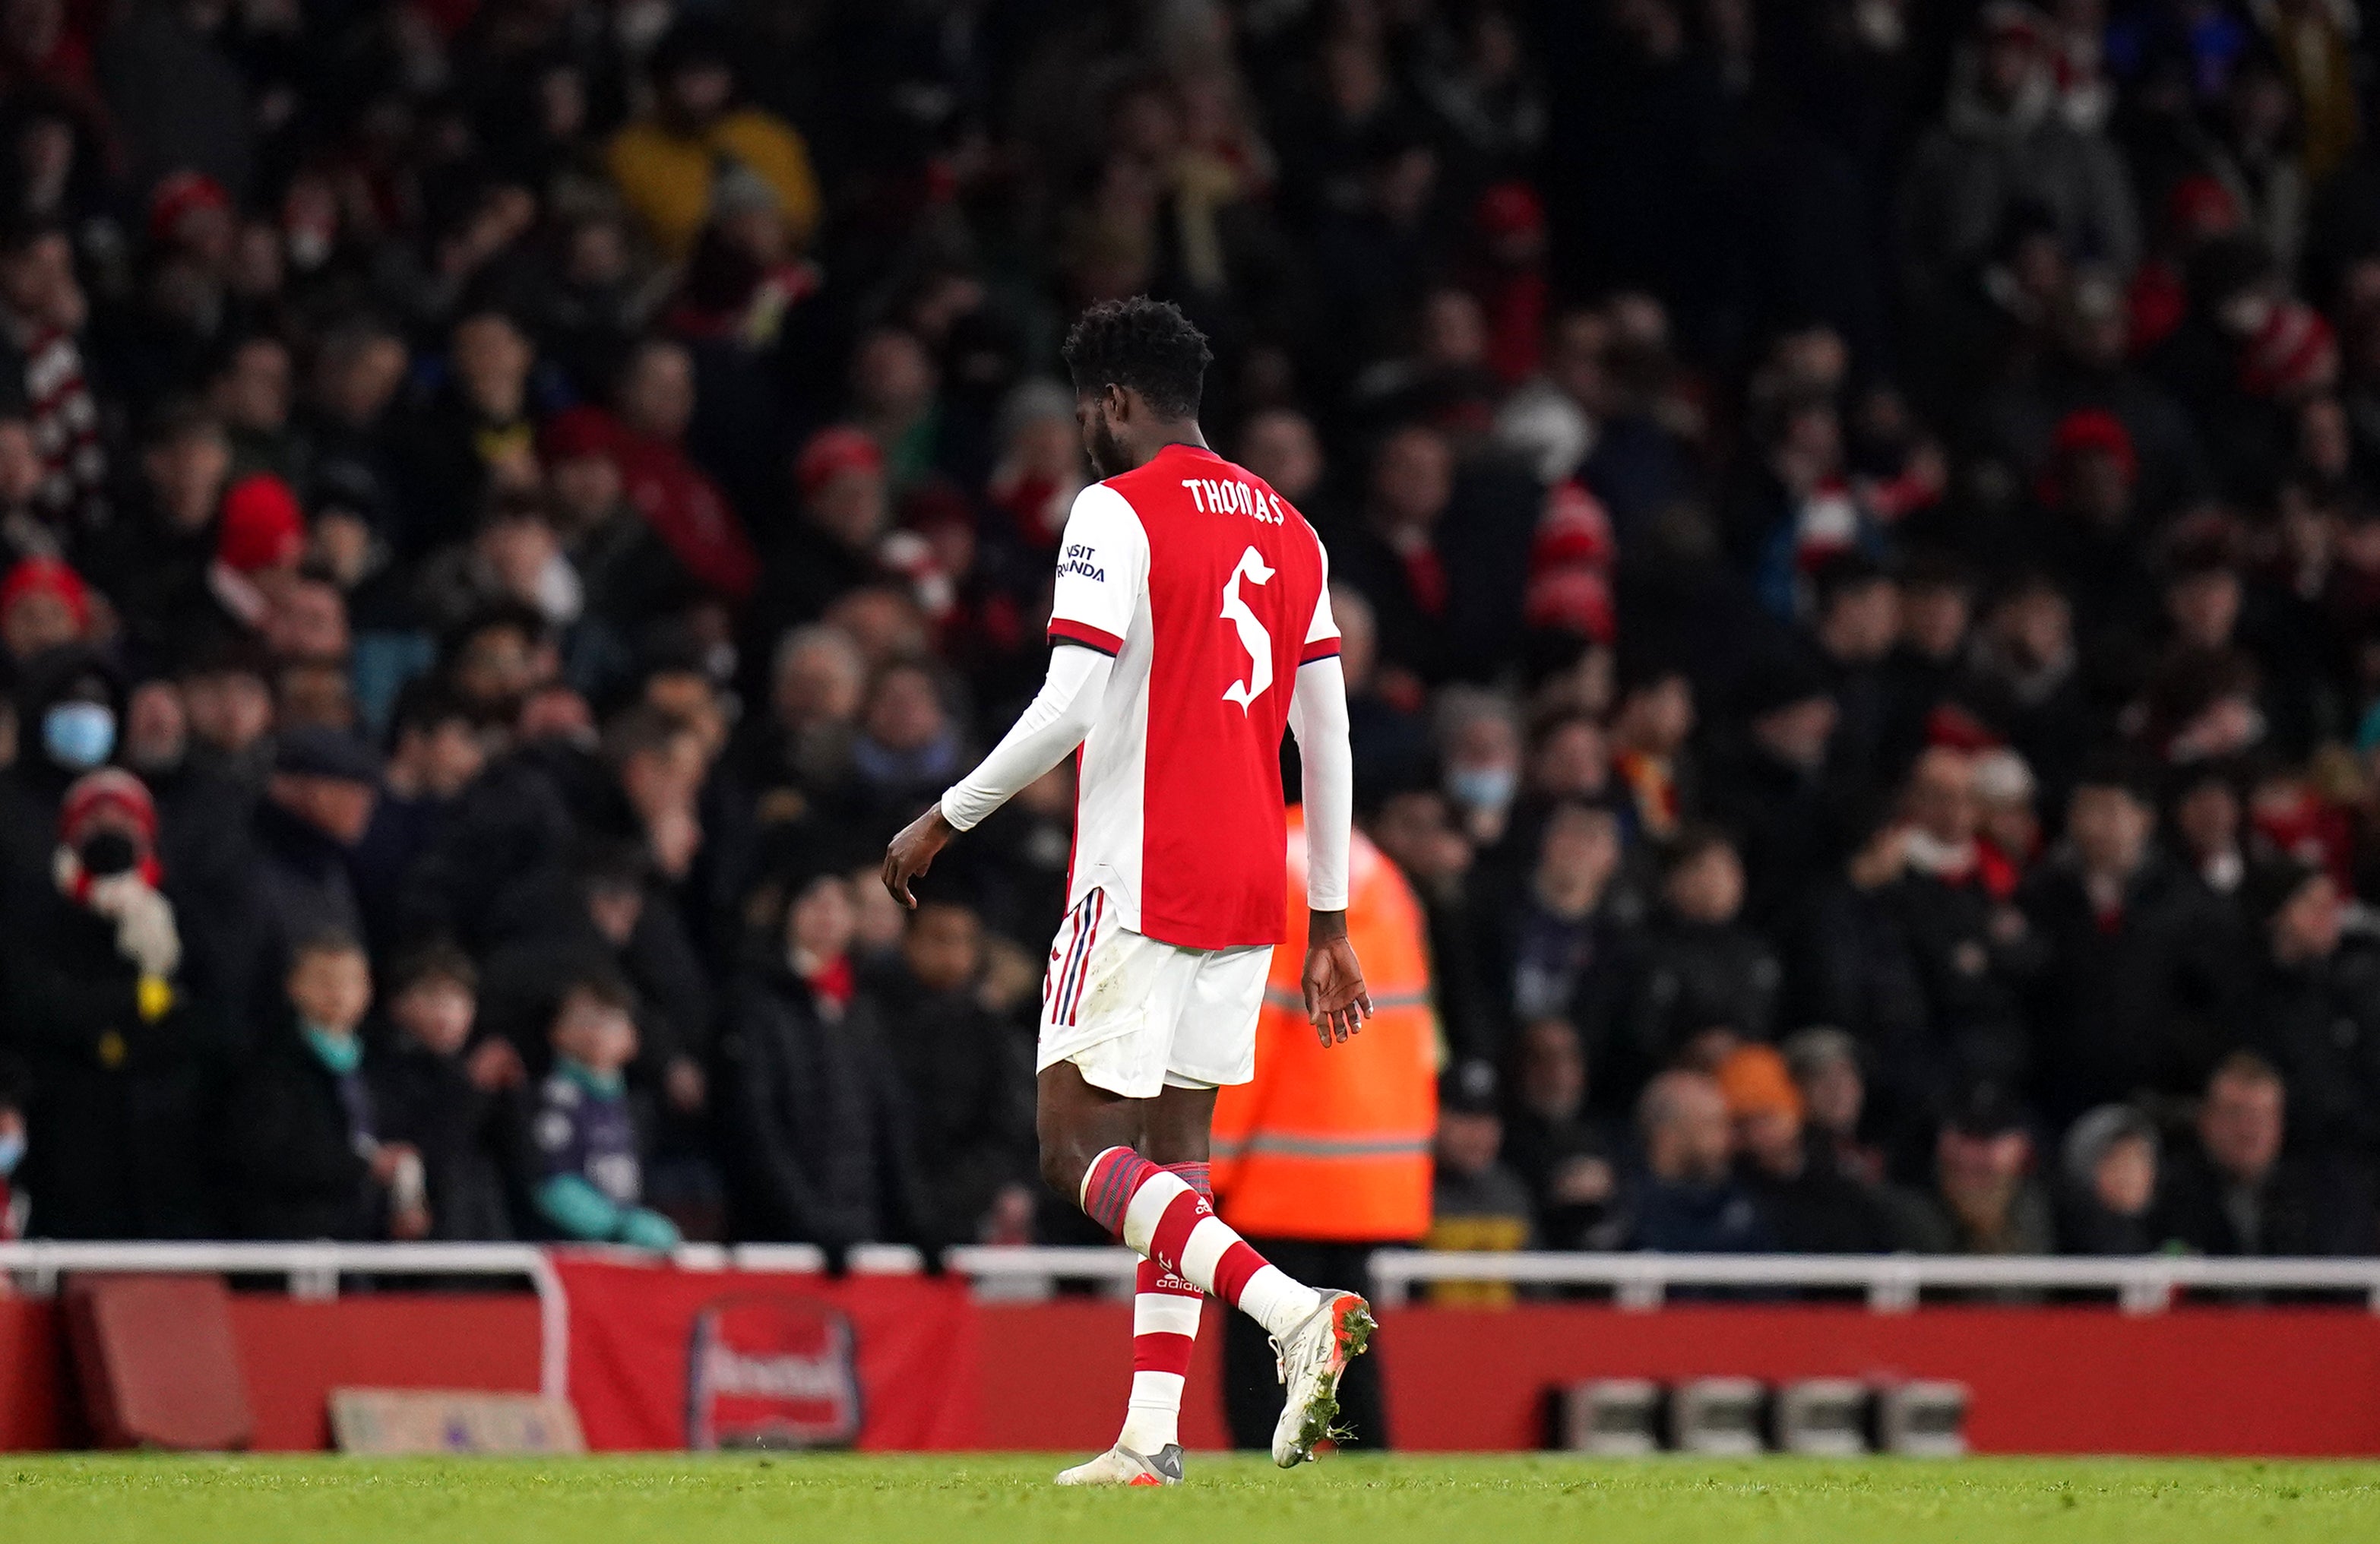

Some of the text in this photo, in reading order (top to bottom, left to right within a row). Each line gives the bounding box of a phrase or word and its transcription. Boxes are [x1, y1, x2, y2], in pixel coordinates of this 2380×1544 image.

[1181, 479, 1285, 526] THOMAS
[1066, 544, 1096, 561] VSIT
[1057, 559, 1104, 582] RWNDA
[1219, 545, 1276, 719] 5
[1156, 1278, 1204, 1294] adida
